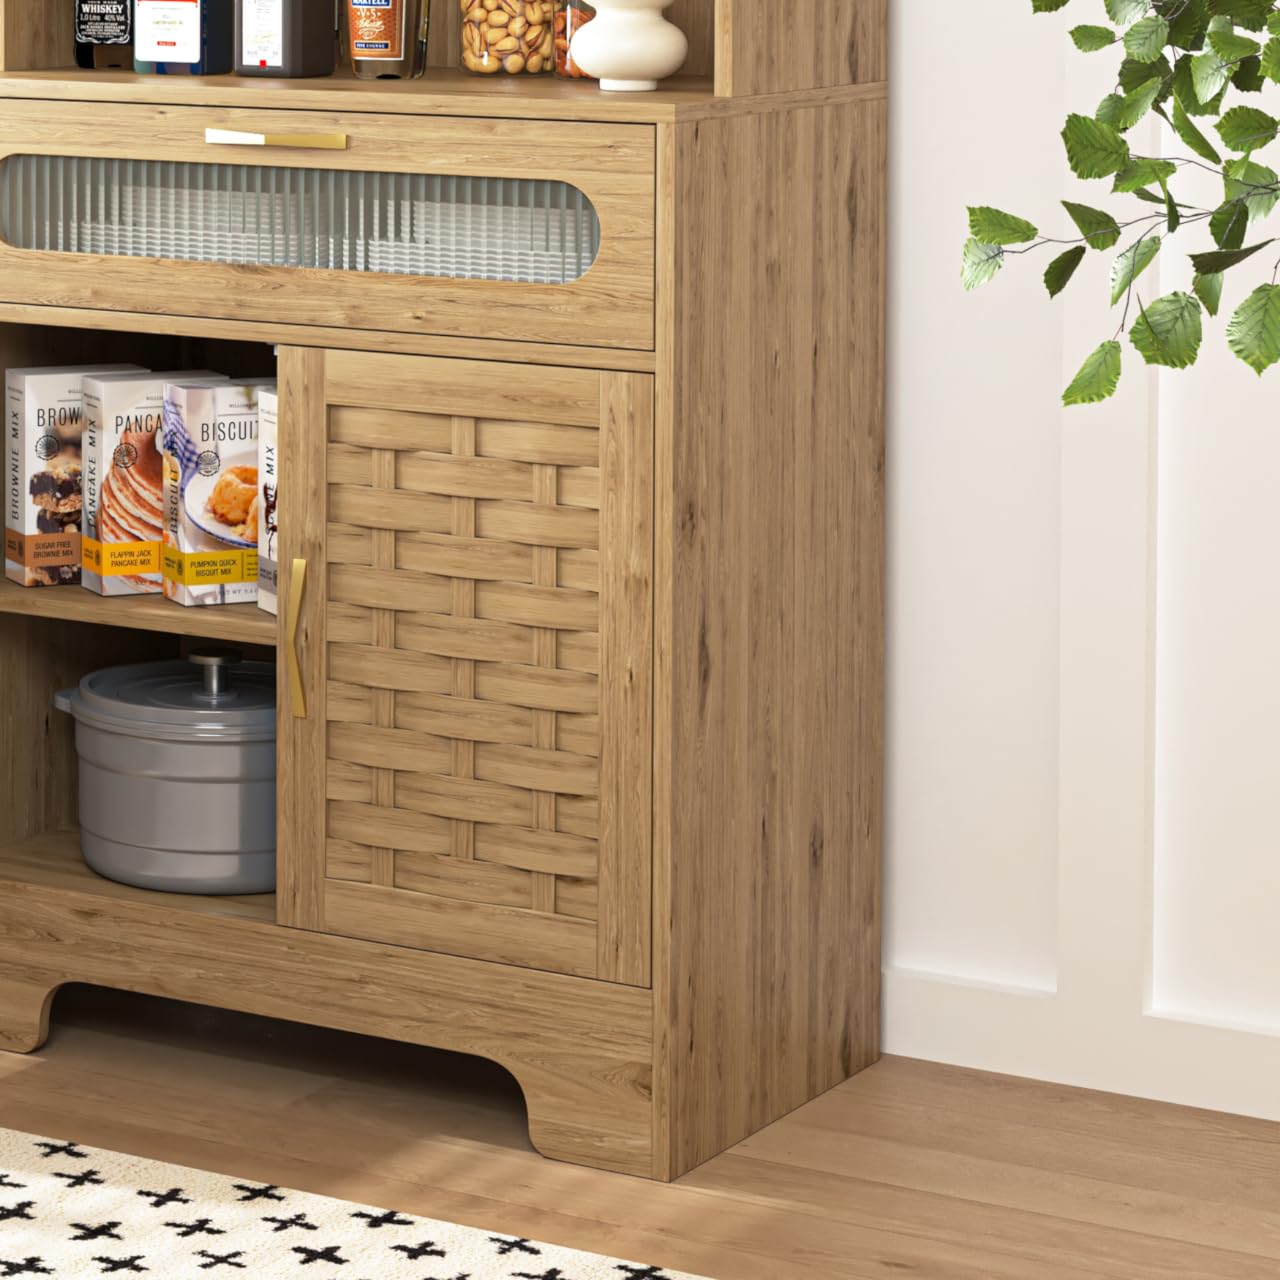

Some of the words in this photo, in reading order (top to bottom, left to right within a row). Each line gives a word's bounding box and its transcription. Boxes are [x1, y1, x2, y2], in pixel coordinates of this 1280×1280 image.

[81, 4, 124, 13] WHISKEY
[11, 410, 19, 439] MIX
[37, 407, 80, 427] BROW
[115, 413, 163, 434] PANCA
[88, 419, 96, 447] MIX
[265, 446, 274, 475] MIX
[11, 448, 19, 520] BROWNIE
[88, 456, 96, 528] PANCAKE
[170, 469, 178, 534] BISCUIT
[33, 550, 61, 559] BROWNIE
[35, 541, 55, 550] SUGAR
[56, 540, 71, 548] FREE
[136, 549, 152, 557] JACK
[111, 559, 138, 567] PANCAKE
[190, 560, 217, 569] PUMPKIN
[219, 559, 237, 567] QUICK
